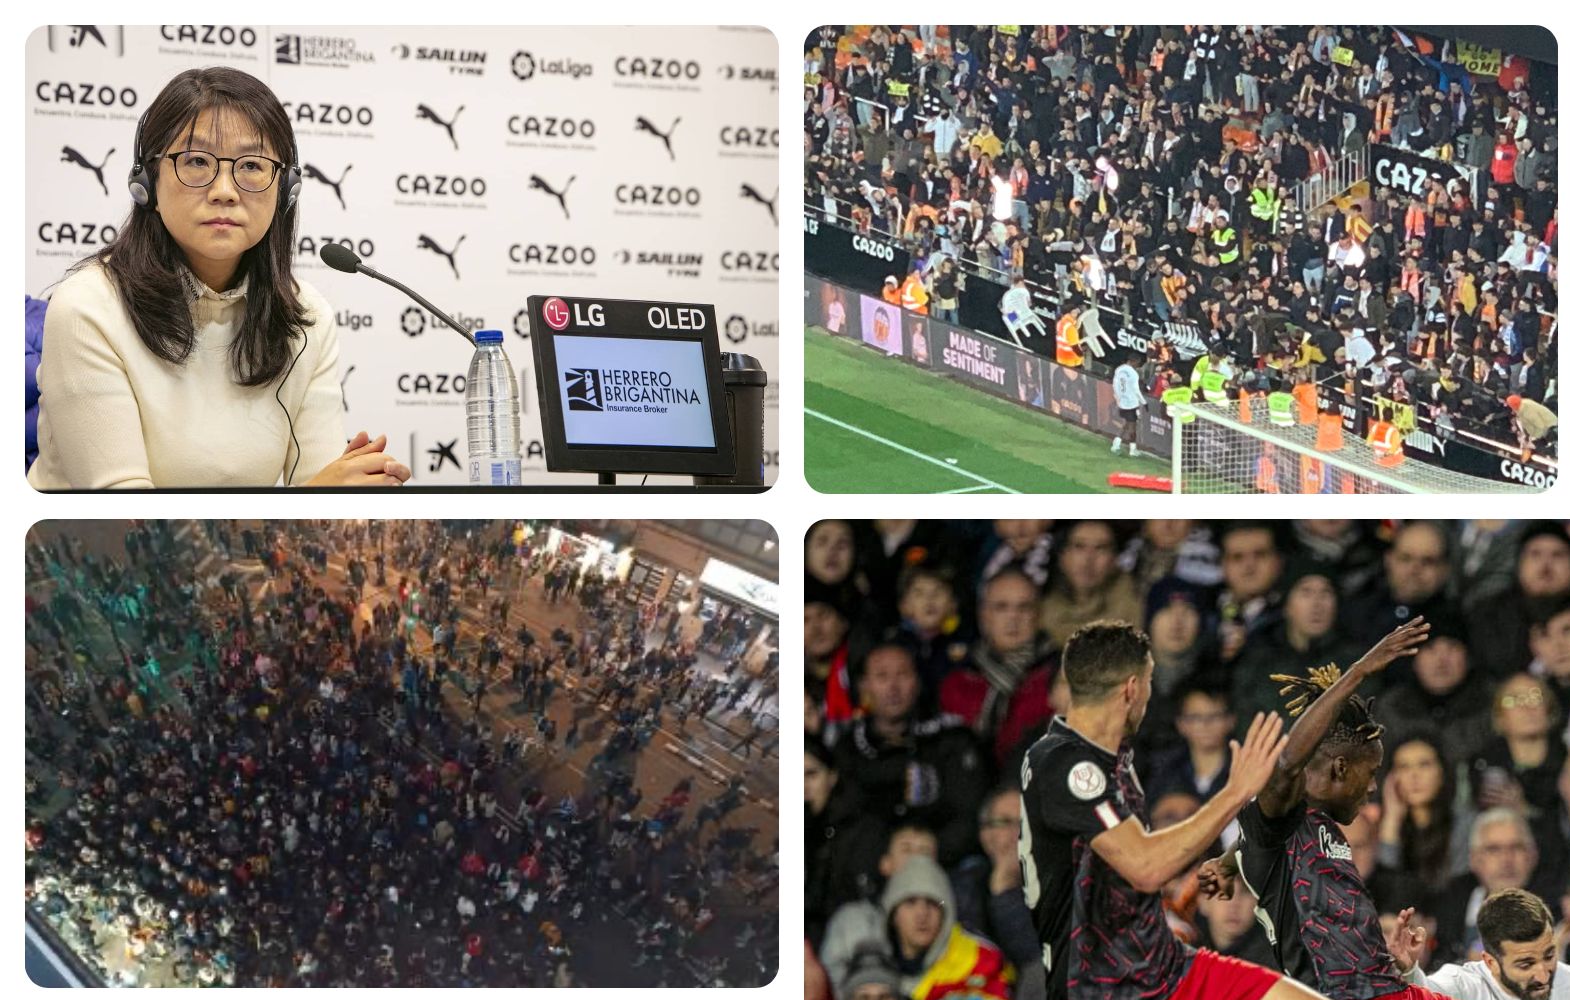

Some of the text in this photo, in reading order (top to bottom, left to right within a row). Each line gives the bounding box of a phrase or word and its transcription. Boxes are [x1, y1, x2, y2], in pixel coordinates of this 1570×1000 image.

[160, 24, 257, 47] CAZOO
[416, 47, 487, 64] SAILUN
[540, 57, 593, 80] LaLiga
[614, 56, 701, 79] CAZOO
[36, 81, 138, 107] CAZOO
[507, 115, 595, 138] CAZOO
[396, 174, 486, 196] CAZOO
[1375, 158, 1427, 195] CAZ
[614, 185, 701, 206] CAZOO
[38, 221, 118, 245] CAZO
[508, 243, 596, 265] CAZOO
[636, 251, 703, 266] SAILUN
[852, 235, 894, 262] CAZOO
[574, 303, 605, 327] LG
[648, 306, 706, 330] OLED
[950, 331, 998, 362] MADE OF
[602, 368, 672, 387] HERRERO
[943, 347, 1006, 386] SENTIMENT
[397, 374, 466, 394] CAZO
[605, 385, 702, 405] BRIGANTINA
[606, 403, 669, 414] Insurance Broker
